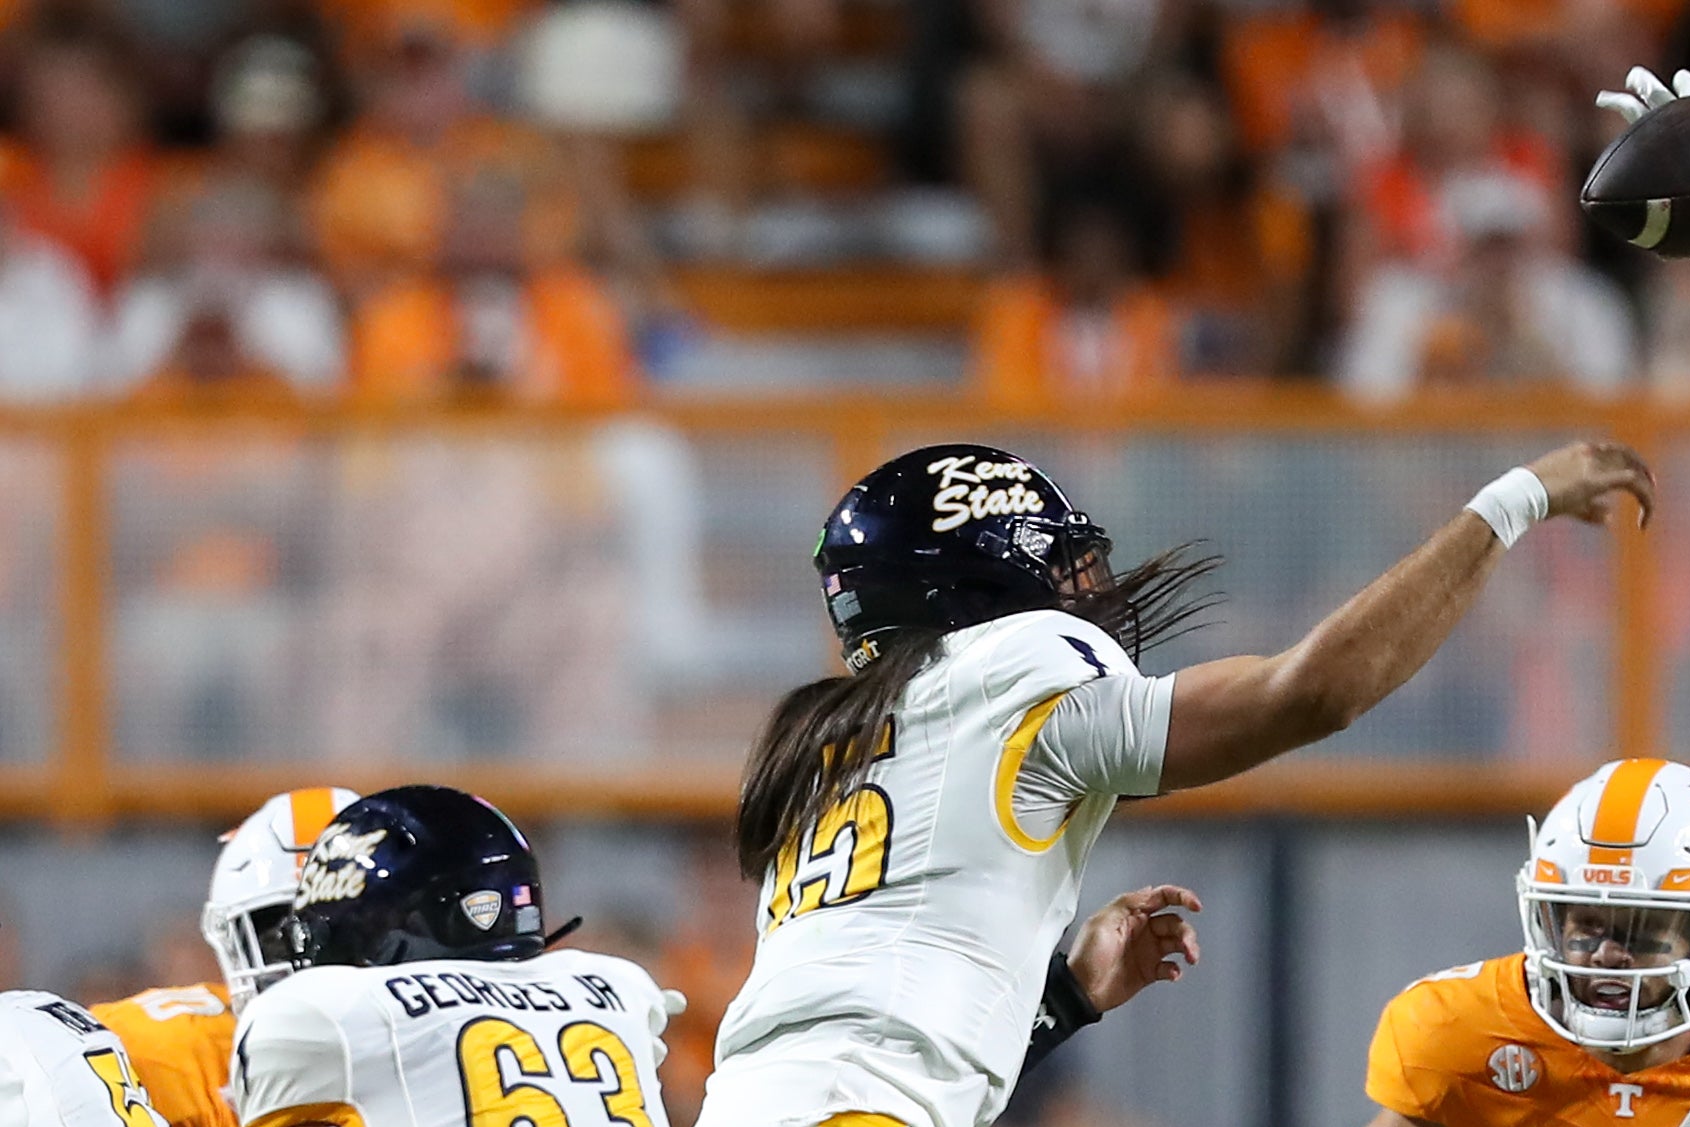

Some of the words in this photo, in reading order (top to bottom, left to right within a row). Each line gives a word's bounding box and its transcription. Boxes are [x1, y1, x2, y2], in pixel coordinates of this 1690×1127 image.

[926, 455, 1033, 489] Kent
[931, 483, 1045, 533] State
[293, 861, 368, 911] State
[1582, 868, 1632, 886] VOLS
[386, 972, 572, 1018] GEORGES
[573, 974, 627, 1013] JR
[1487, 1043, 1541, 1092] SEC
[1609, 1083, 1643, 1118] T
